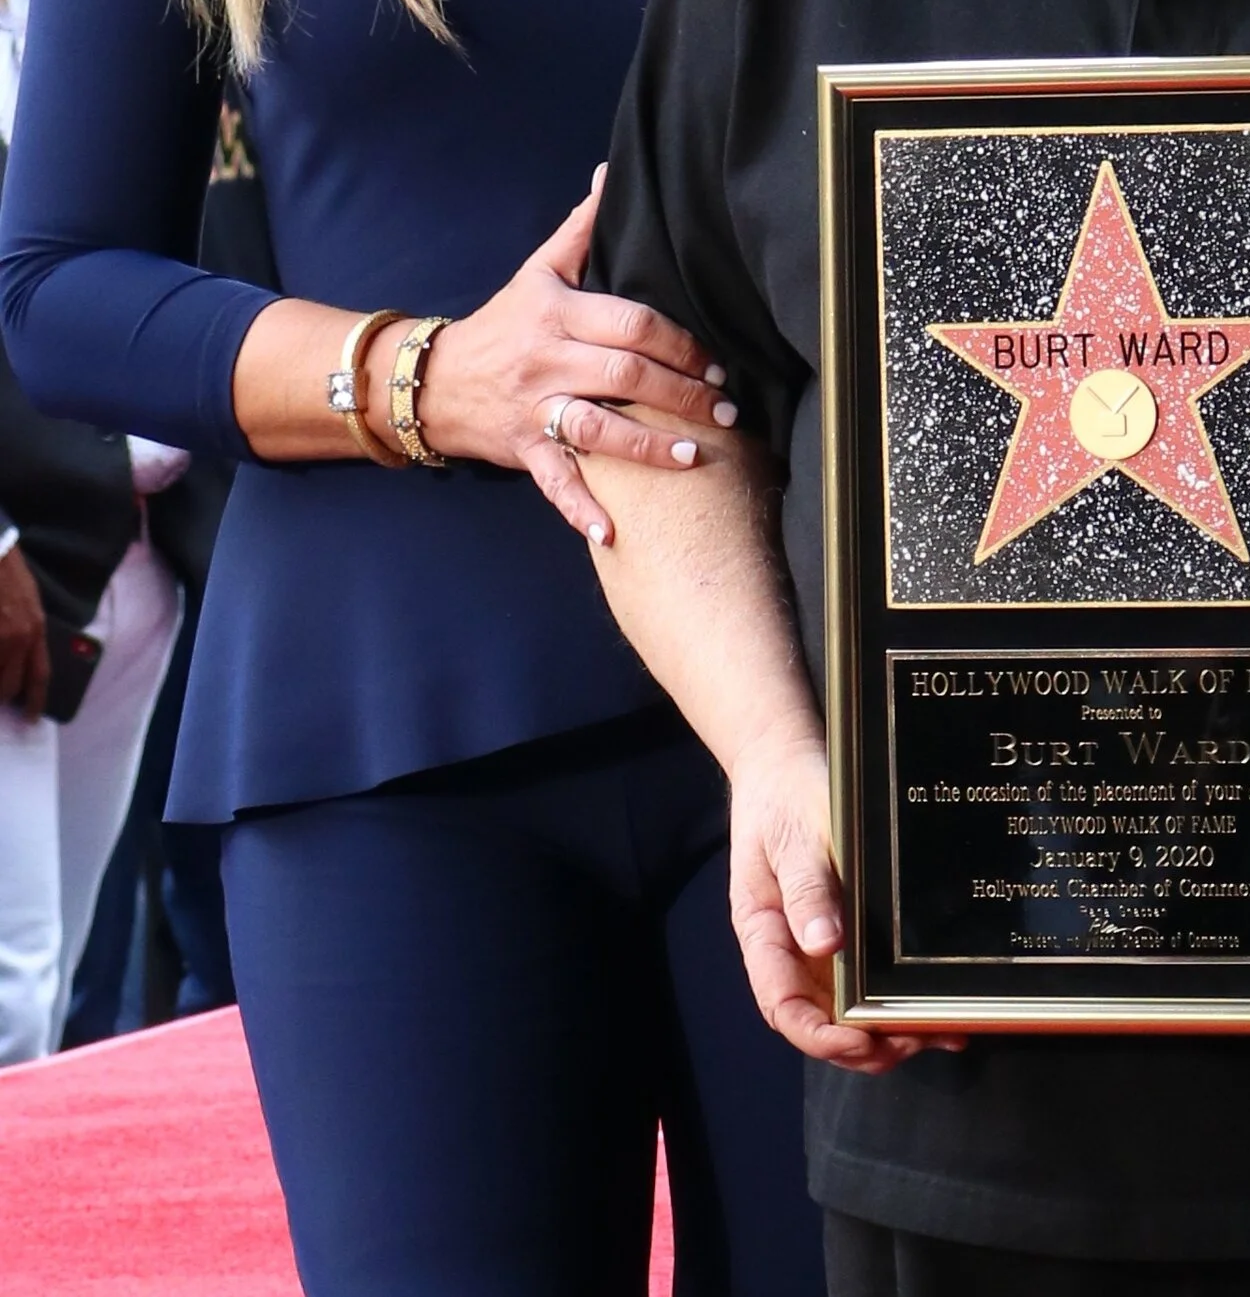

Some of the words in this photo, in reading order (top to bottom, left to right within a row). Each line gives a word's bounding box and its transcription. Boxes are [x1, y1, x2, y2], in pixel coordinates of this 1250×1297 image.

[994, 332, 1095, 371] BURT
[1118, 331, 1232, 368] WARD
[911, 670, 1090, 697] HOLLYWOOD
[1101, 669, 1188, 695] WALK
[1199, 668, 1235, 694] OF
[1081, 704, 1144, 721] Presented
[1148, 707, 1162, 721] to
[907, 787, 928, 802] on
[933, 781, 961, 802] the
[966, 783, 1031, 802] occasion
[1037, 781, 1054, 802] of
[1059, 781, 1087, 801] the
[1092, 780, 1176, 807] placement
[1181, 780, 1198, 801] of
[1204, 784, 1242, 806] your
[1007, 816, 1107, 835] HOLLYWOOD
[1111, 816, 1160, 835] WALK
[1165, 815, 1187, 835] OF
[1191, 815, 1237, 834] FAME
[1030, 846, 1121, 873] January
[1155, 845, 1214, 868] 2020
[972, 879, 1060, 901] Hollywood
[1067, 878, 1148, 898] Chamber
[1153, 878, 1172, 898] of
